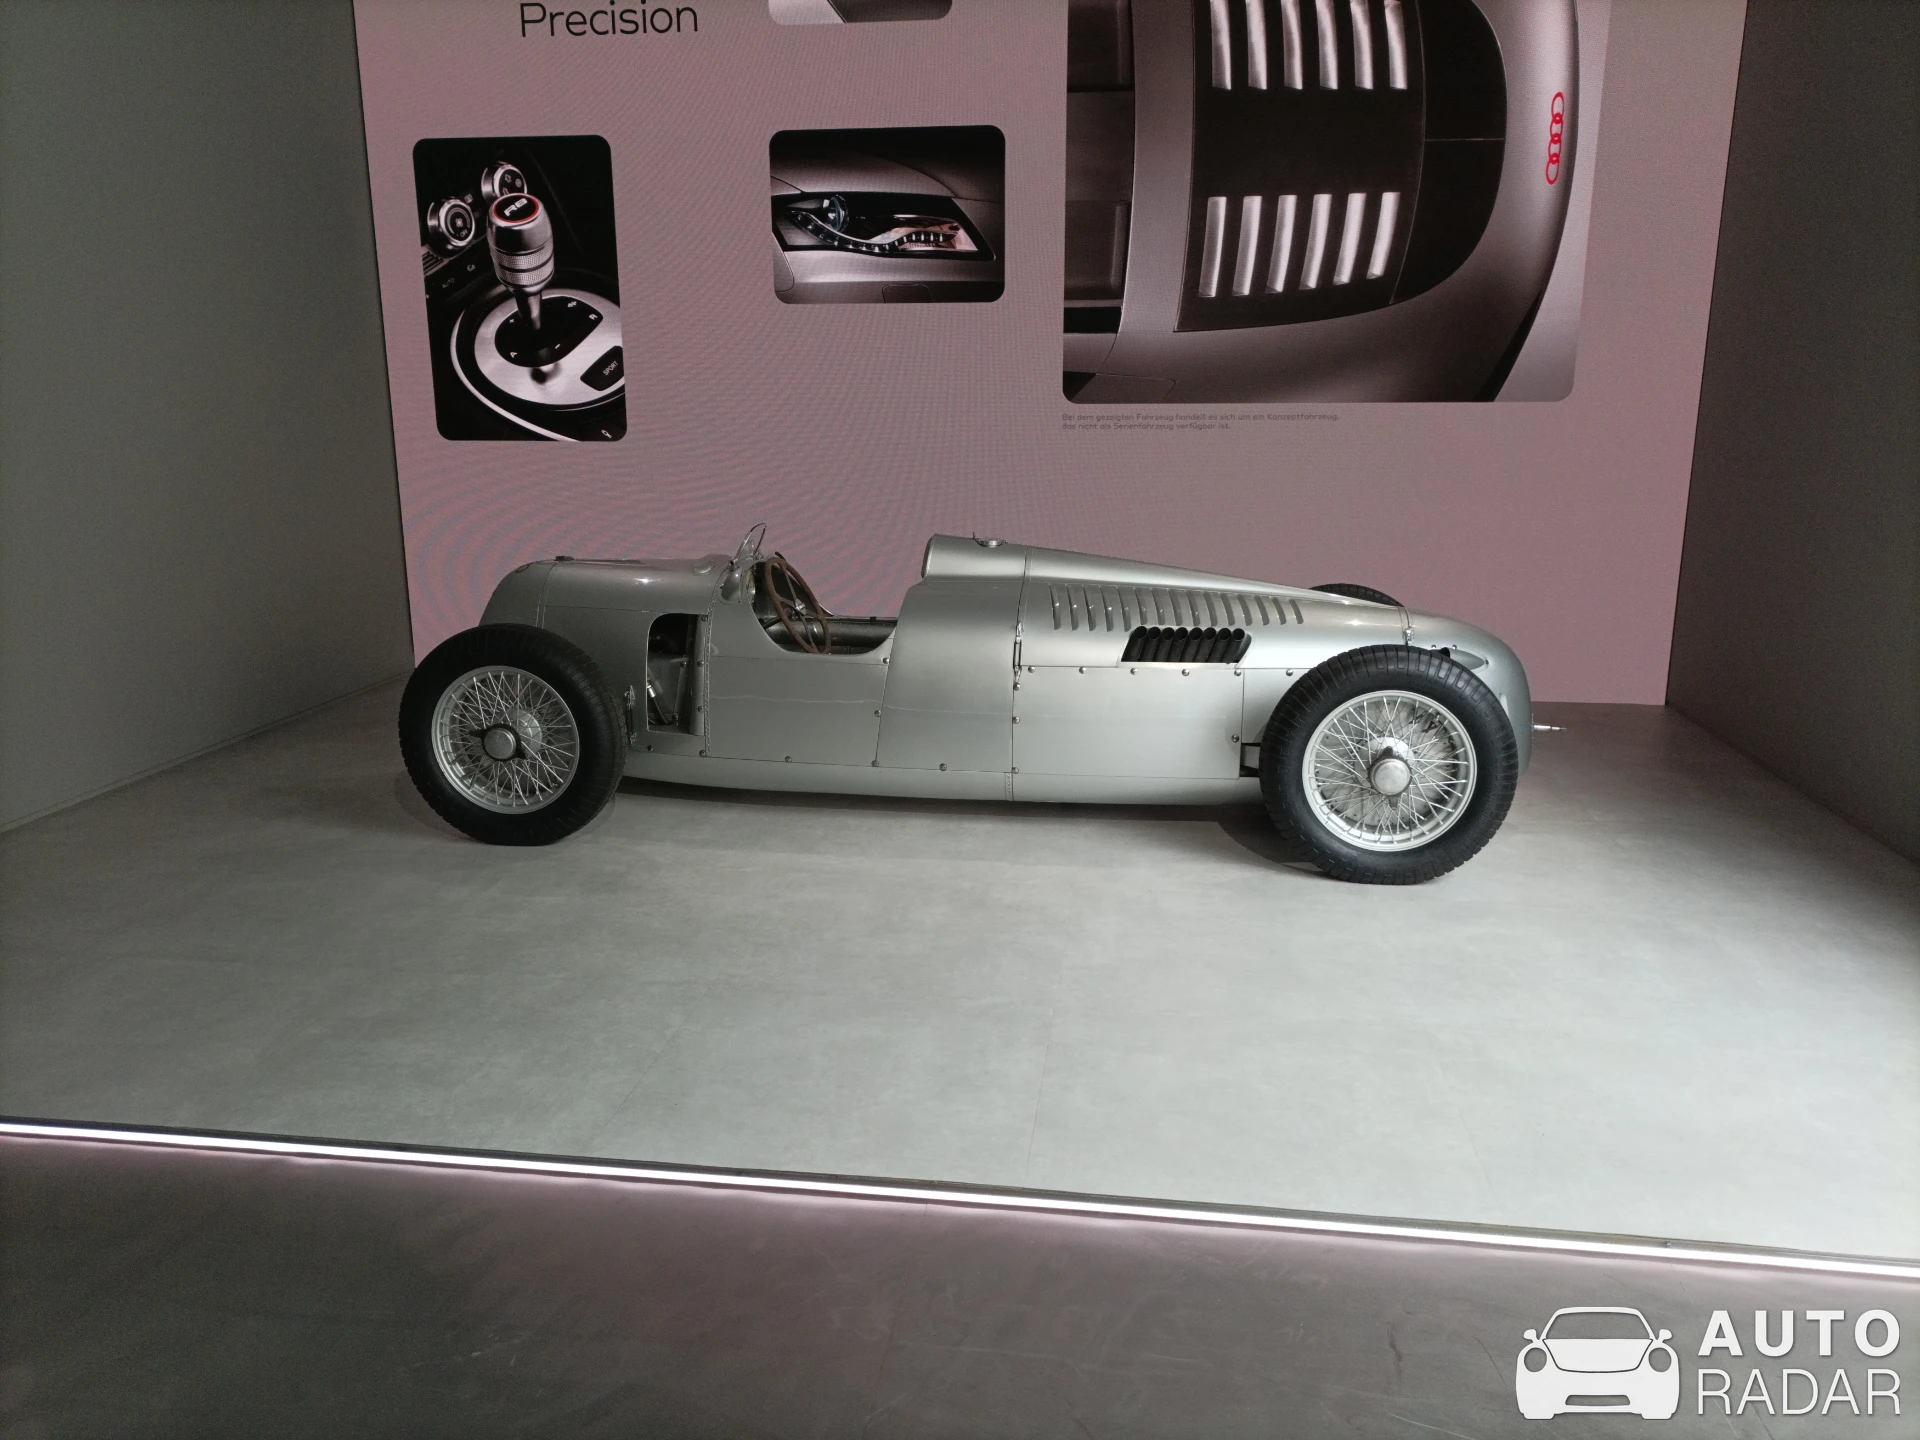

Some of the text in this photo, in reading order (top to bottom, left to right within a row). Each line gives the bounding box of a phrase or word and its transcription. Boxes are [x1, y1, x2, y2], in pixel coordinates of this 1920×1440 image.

[520, 0, 698, 37] Precision
[504, 198, 528, 217] R8
[602, 361, 618, 376] SPORT
[1062, 413, 1075, 421] Bei
[1077, 413, 1094, 421] dem
[1096, 413, 1134, 422] gezeigten
[1136, 413, 1174, 422] Fahrzeug
[1176, 412, 1206, 421] handelt
[1220, 413, 1236, 421] sich
[1253, 413, 1265, 421] ein
[1062, 422, 1231, 431] das nicht als Serienfahrzeug verfügbar ist.
